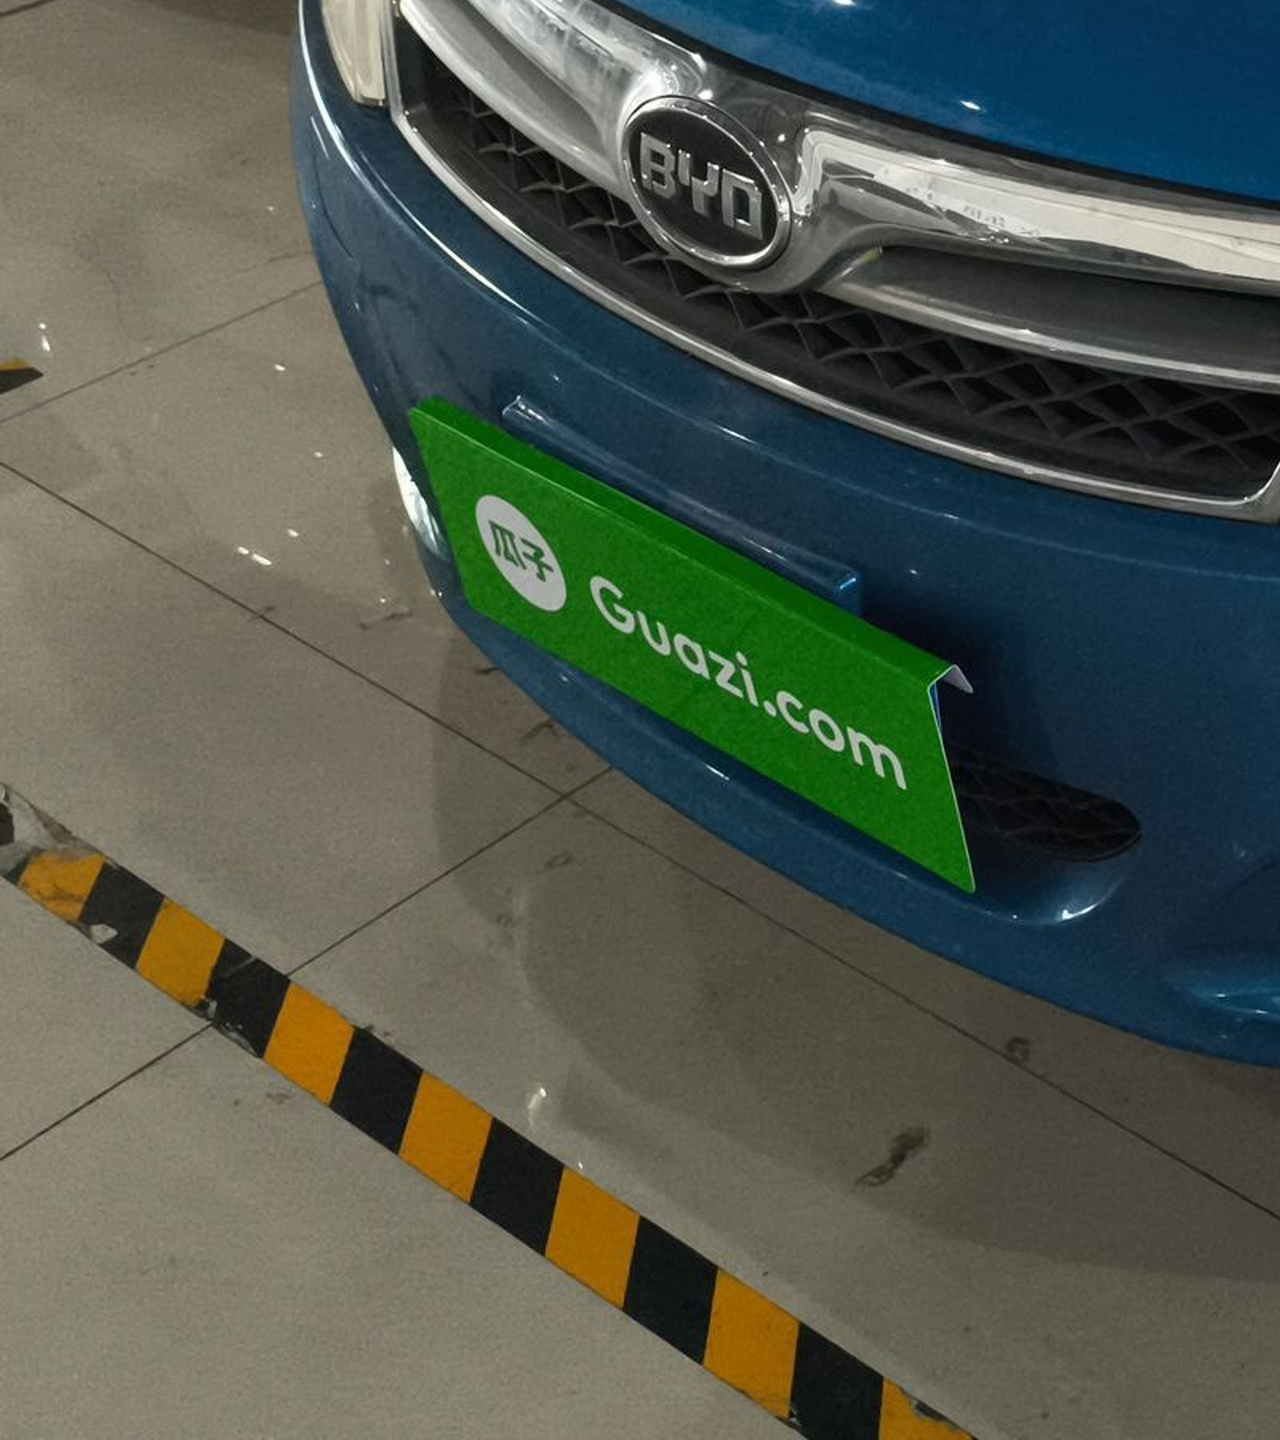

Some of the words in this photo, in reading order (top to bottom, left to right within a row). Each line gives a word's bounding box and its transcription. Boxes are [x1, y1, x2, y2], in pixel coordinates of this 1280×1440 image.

[639, 132, 764, 242] BYD
[486, 518, 554, 585] 瓜子
[589, 575, 909, 791] Guazi.com
